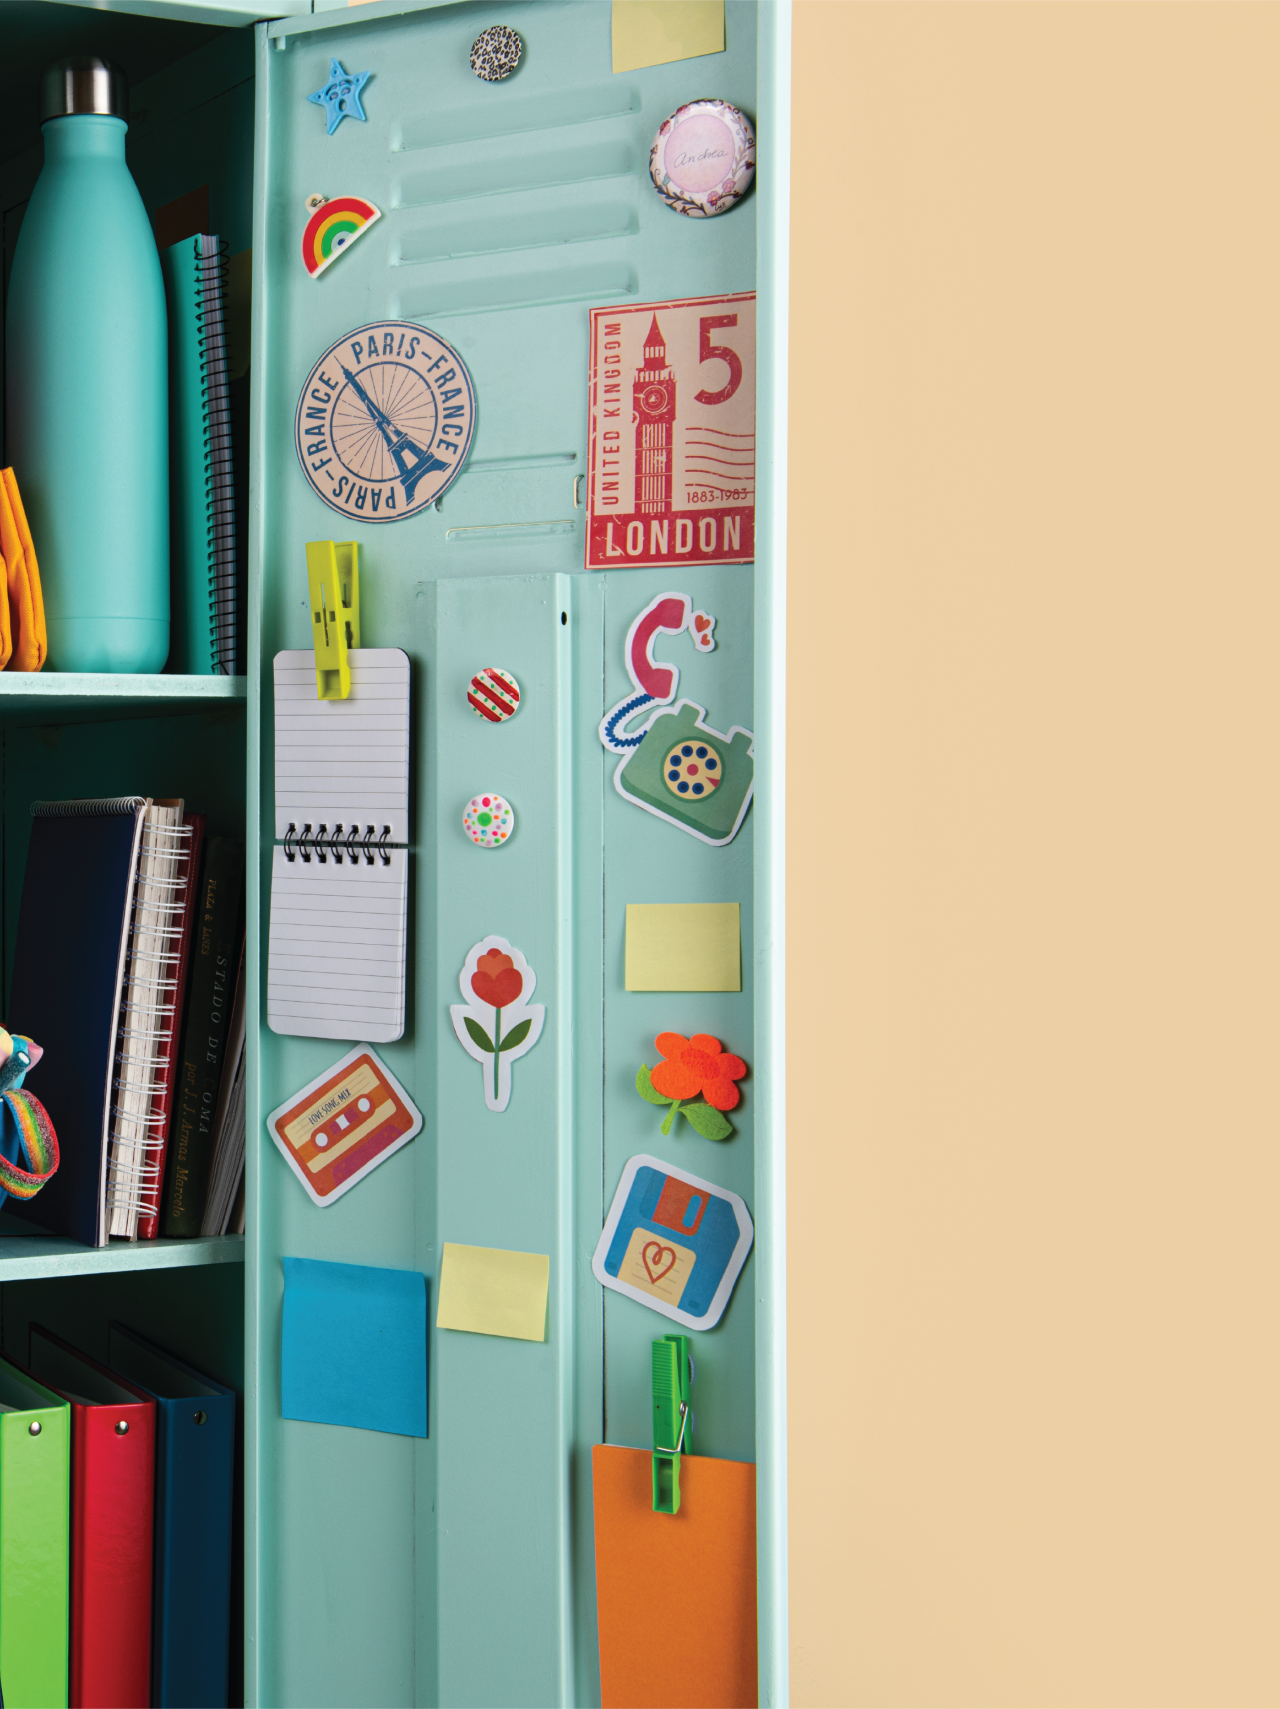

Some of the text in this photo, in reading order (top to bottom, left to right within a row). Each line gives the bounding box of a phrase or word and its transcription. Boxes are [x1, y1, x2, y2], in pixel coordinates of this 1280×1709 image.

[674, 148, 728, 168] Andrea
[694, 313, 743, 406] 5
[601, 323, 622, 506] UNITED KINGDOM
[686, 488, 748, 504] 1883-1983
[606, 515, 741, 557] LONDON
[206, 879, 217, 910] PLAZA
[204, 914, 213, 922] &
[207, 1036, 219, 1064] DE
[308, 1088, 351, 1125] LOVE SONG MIX
[172, 1061, 197, 1218] por J. J. Armas Marcelo
